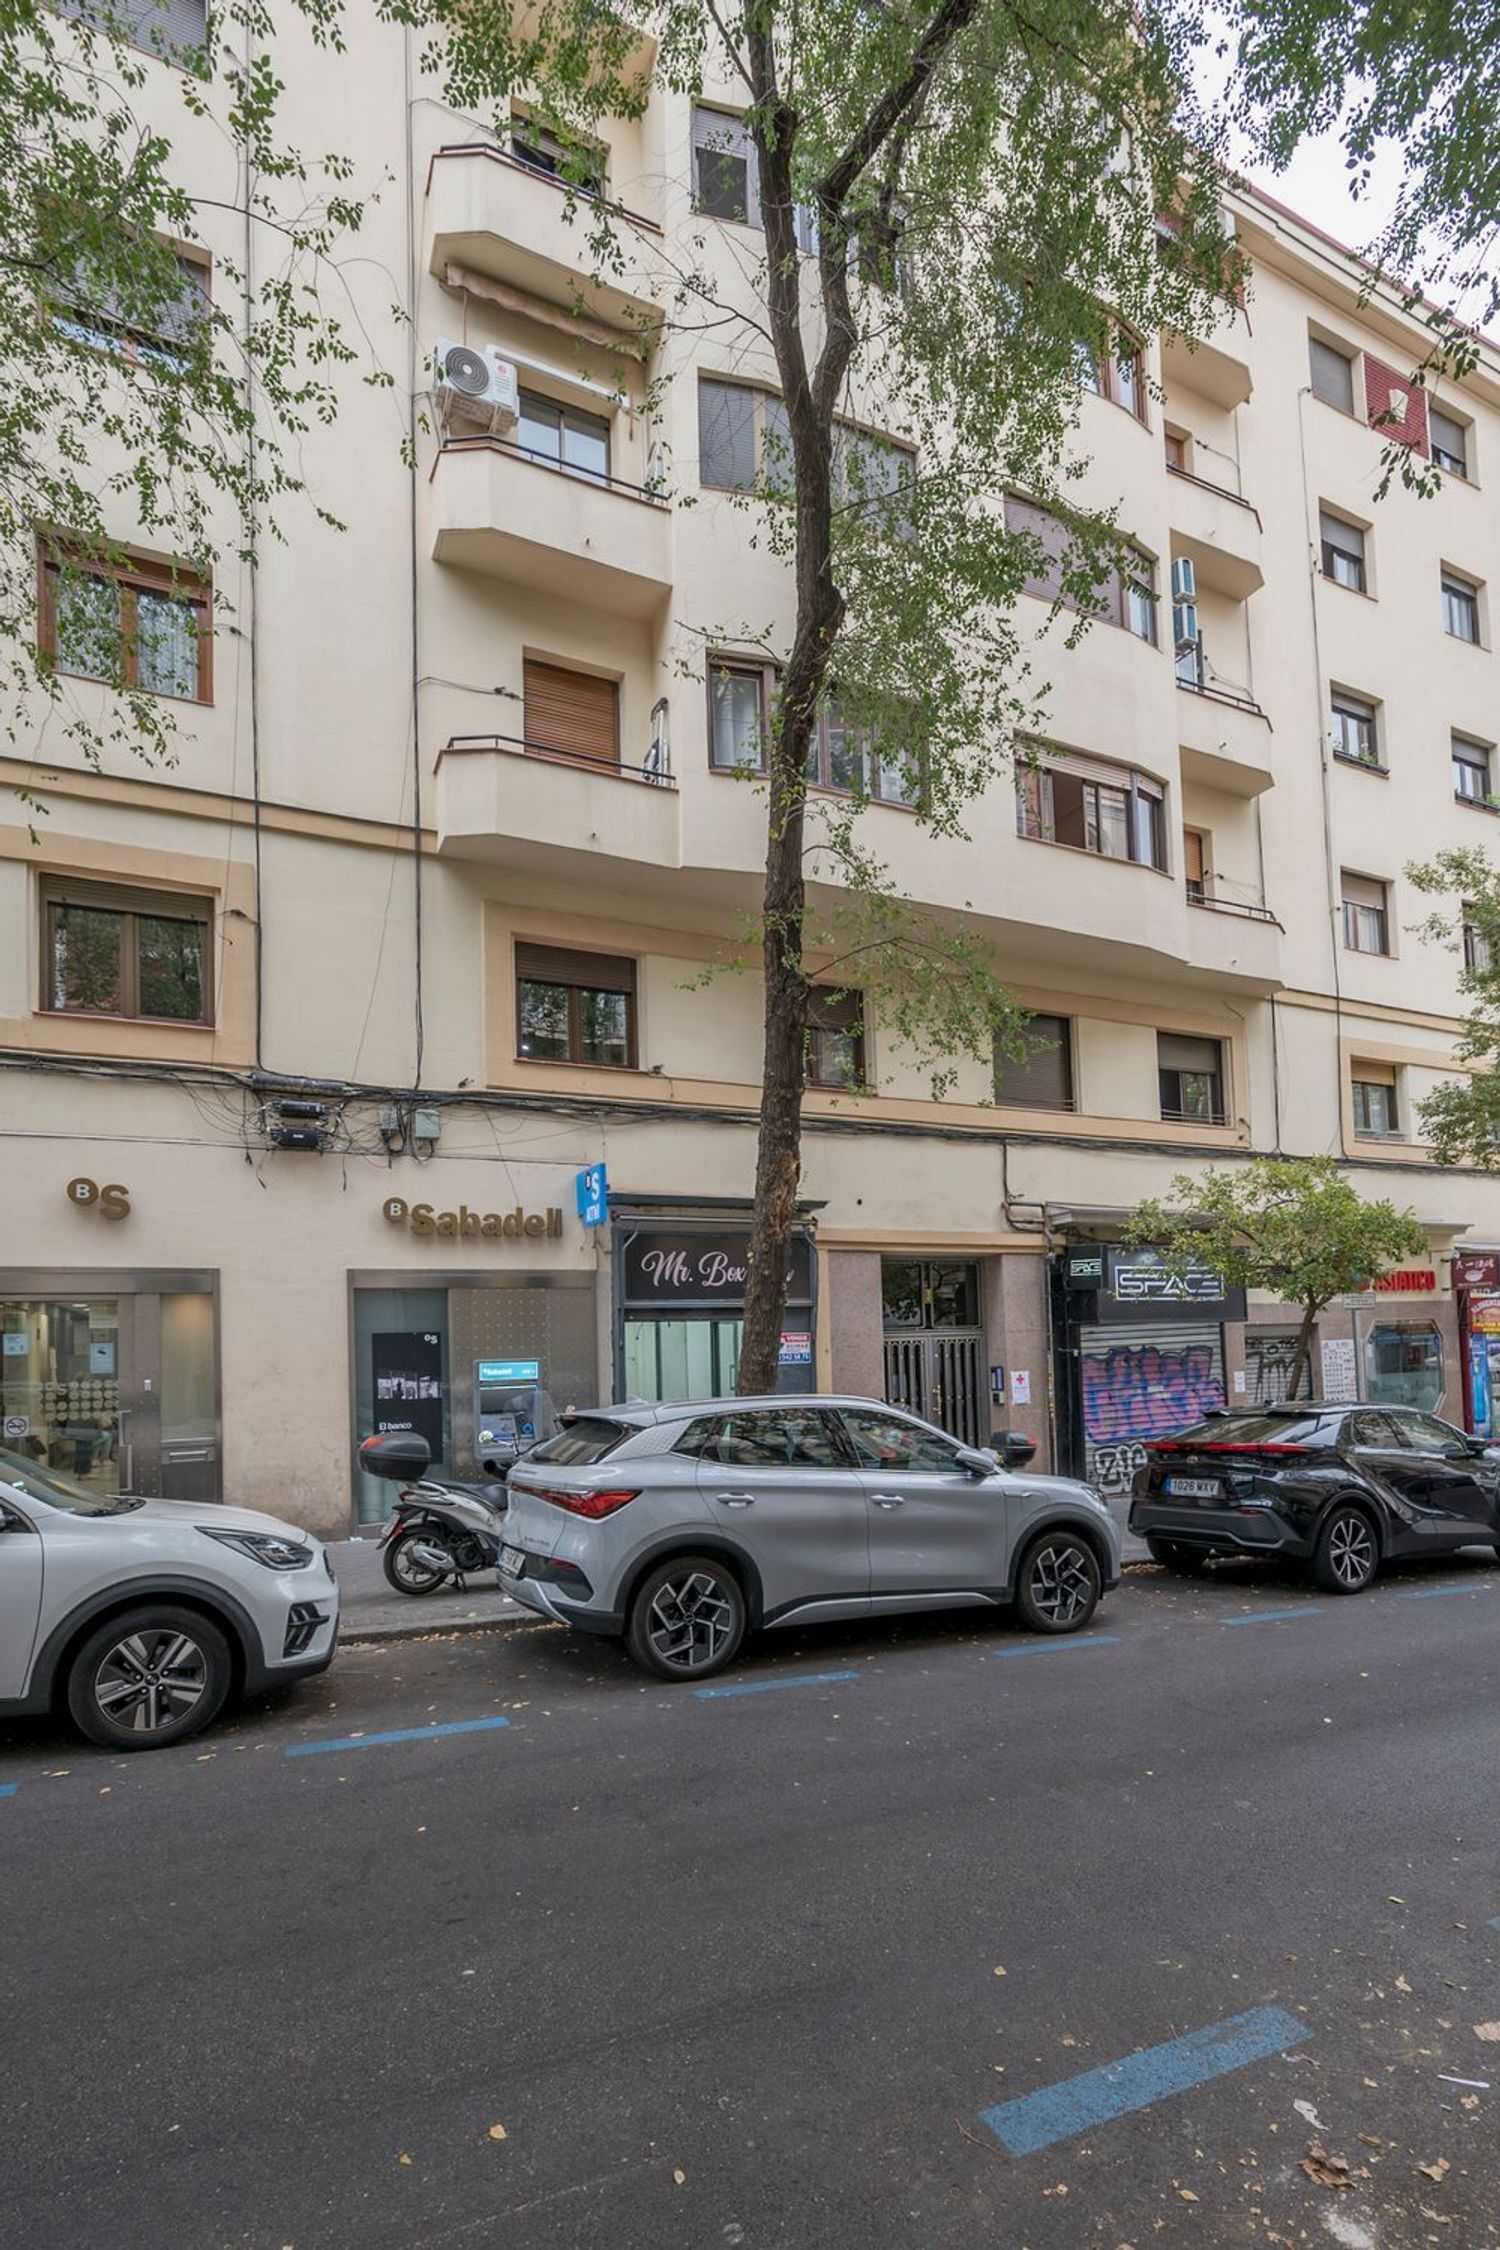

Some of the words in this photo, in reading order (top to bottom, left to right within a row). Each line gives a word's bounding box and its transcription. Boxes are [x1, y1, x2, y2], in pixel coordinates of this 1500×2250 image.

[641, 1250, 693, 1287] Mr.
[698, 1250, 747, 1287] Box
[387, 1422, 412, 1430] banco
